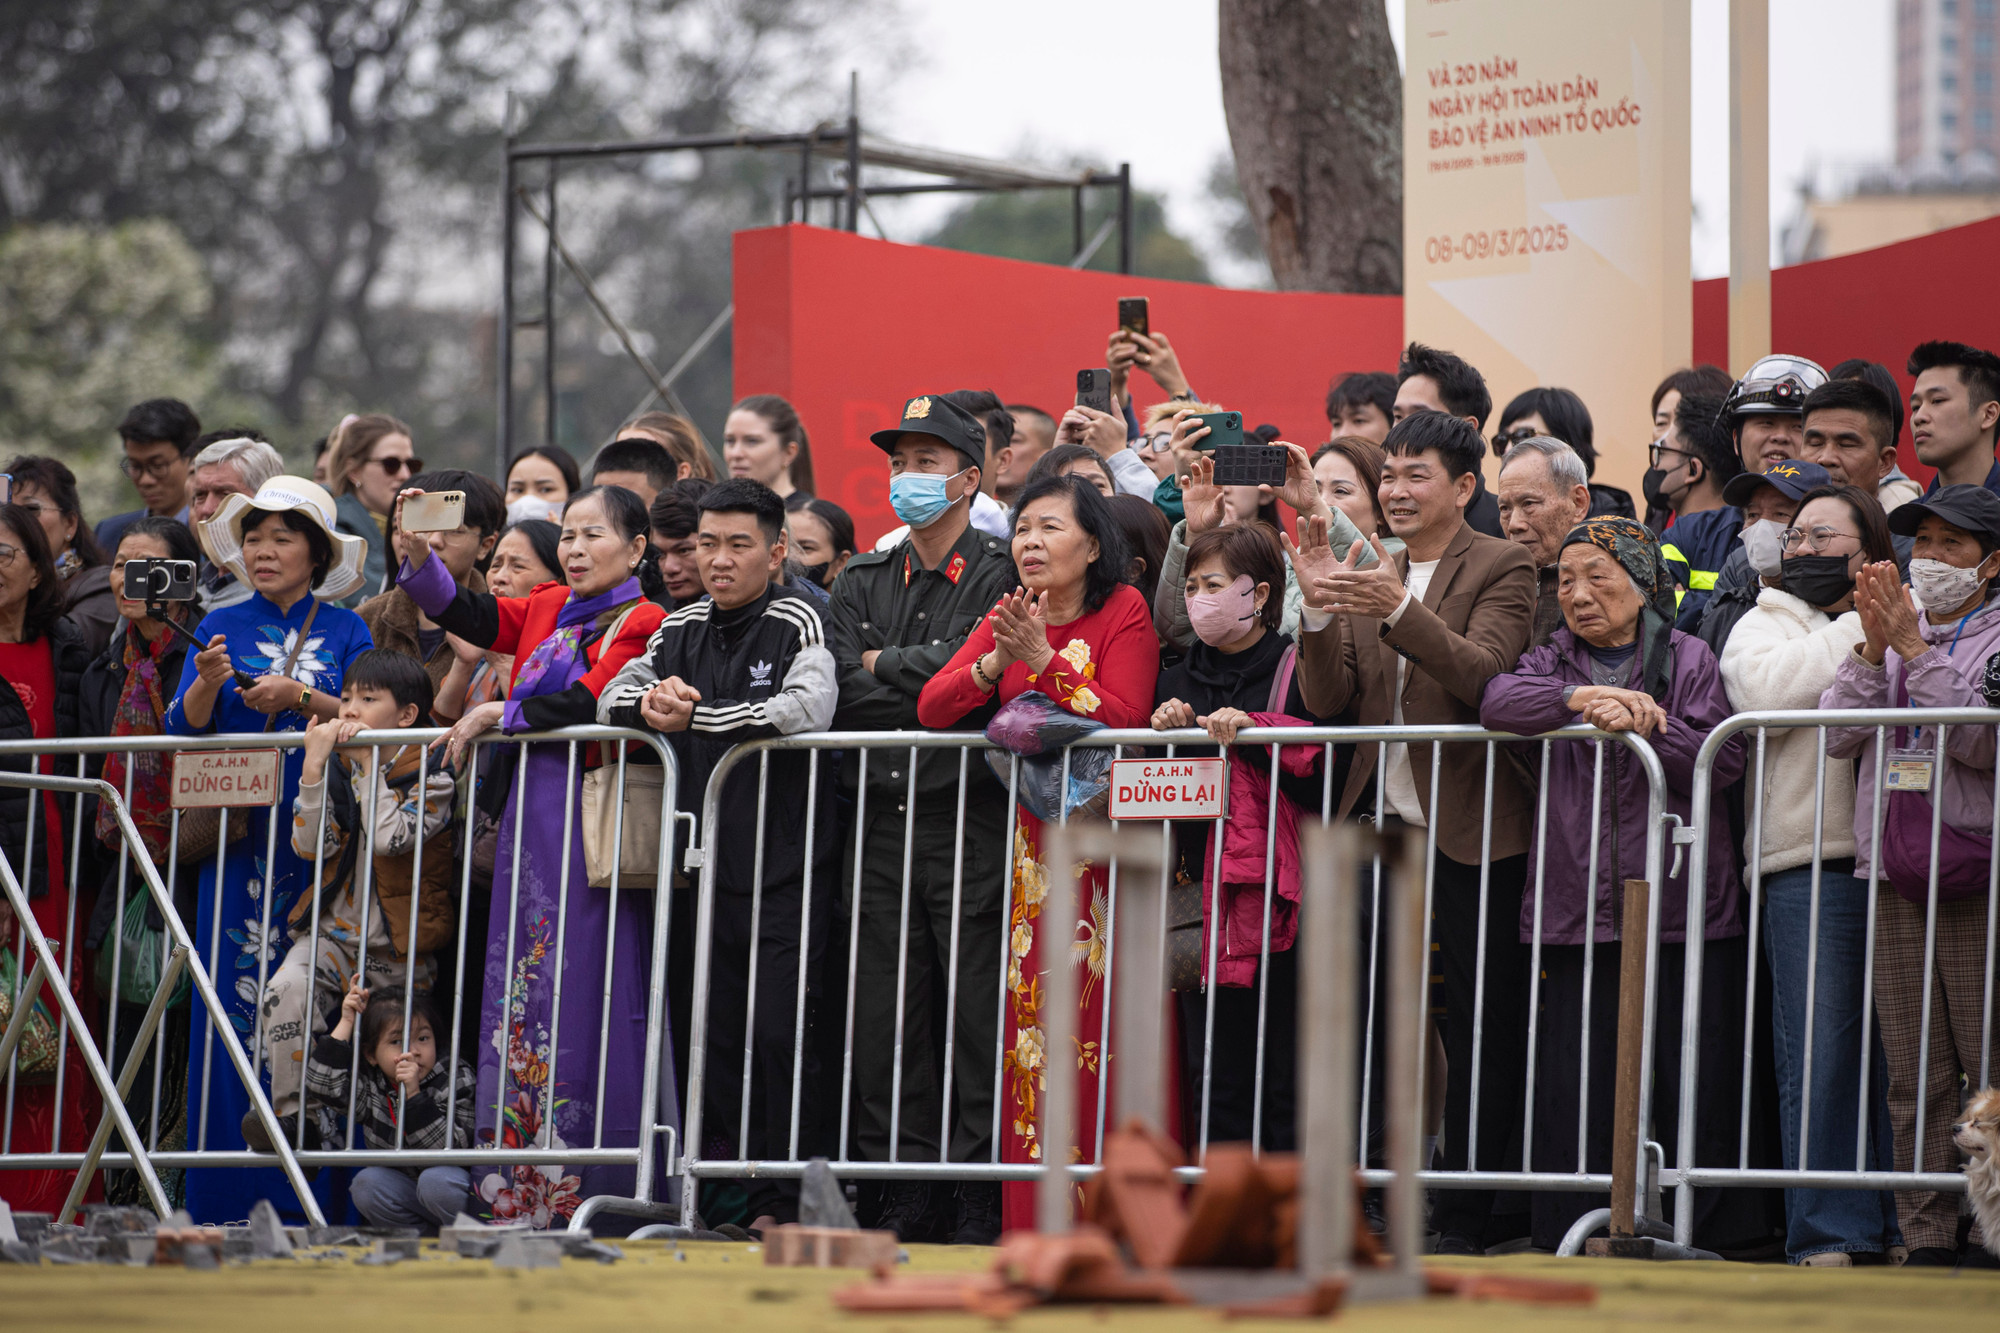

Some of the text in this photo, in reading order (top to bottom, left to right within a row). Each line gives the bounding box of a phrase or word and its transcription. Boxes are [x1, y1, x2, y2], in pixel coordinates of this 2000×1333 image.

[1455, 65, 1476, 86] 20
[1480, 56, 1518, 82] NĂM
[1428, 74, 1598, 118] NGÀY HỘI TOÀN DÂN
[1428, 121, 1464, 149] BẢO
[1467, 117, 1488, 150] VỆ
[1492, 120, 1515, 142] AN
[1520, 115, 1561, 138] NINH
[1591, 95, 1641, 134] QUỐC
[1425, 223, 1569, 264] 08-09/3/2025
[264, 490, 302, 504] Christian
[750, 679, 772, 688] adidas
[202, 757, 249, 769] C.A.H.N
[1143, 765, 1193, 777] C.A.H.N
[179, 771, 269, 795] DỪNG LẠI
[1119, 779, 1215, 806] DỪNG LẠI
